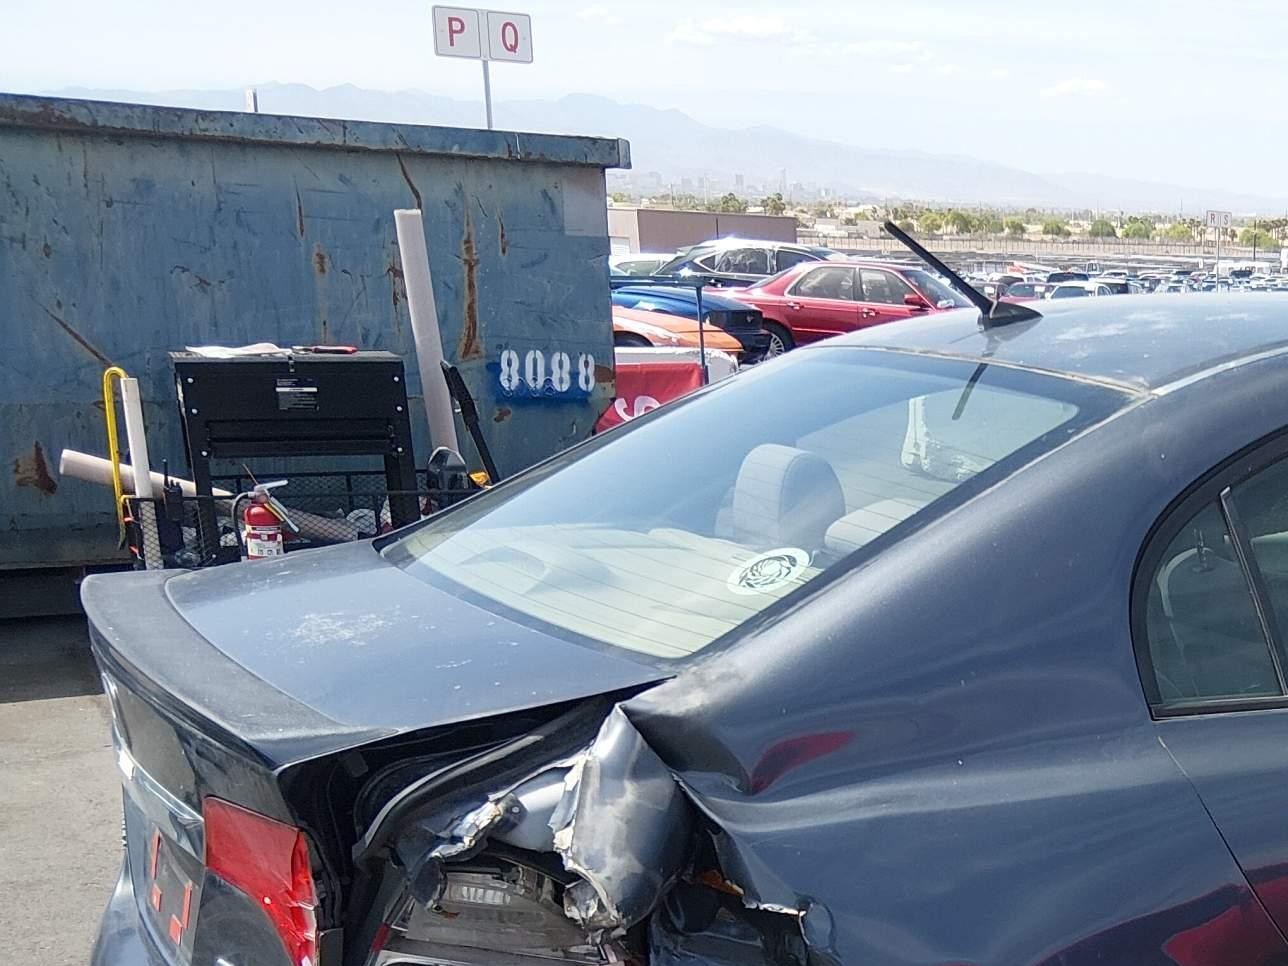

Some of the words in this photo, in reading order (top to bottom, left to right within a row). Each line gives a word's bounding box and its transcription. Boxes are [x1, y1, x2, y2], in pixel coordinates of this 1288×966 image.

[447, 16, 466, 47] P
[501, 21, 519, 54] Q
[499, 350, 595, 393] 8088
